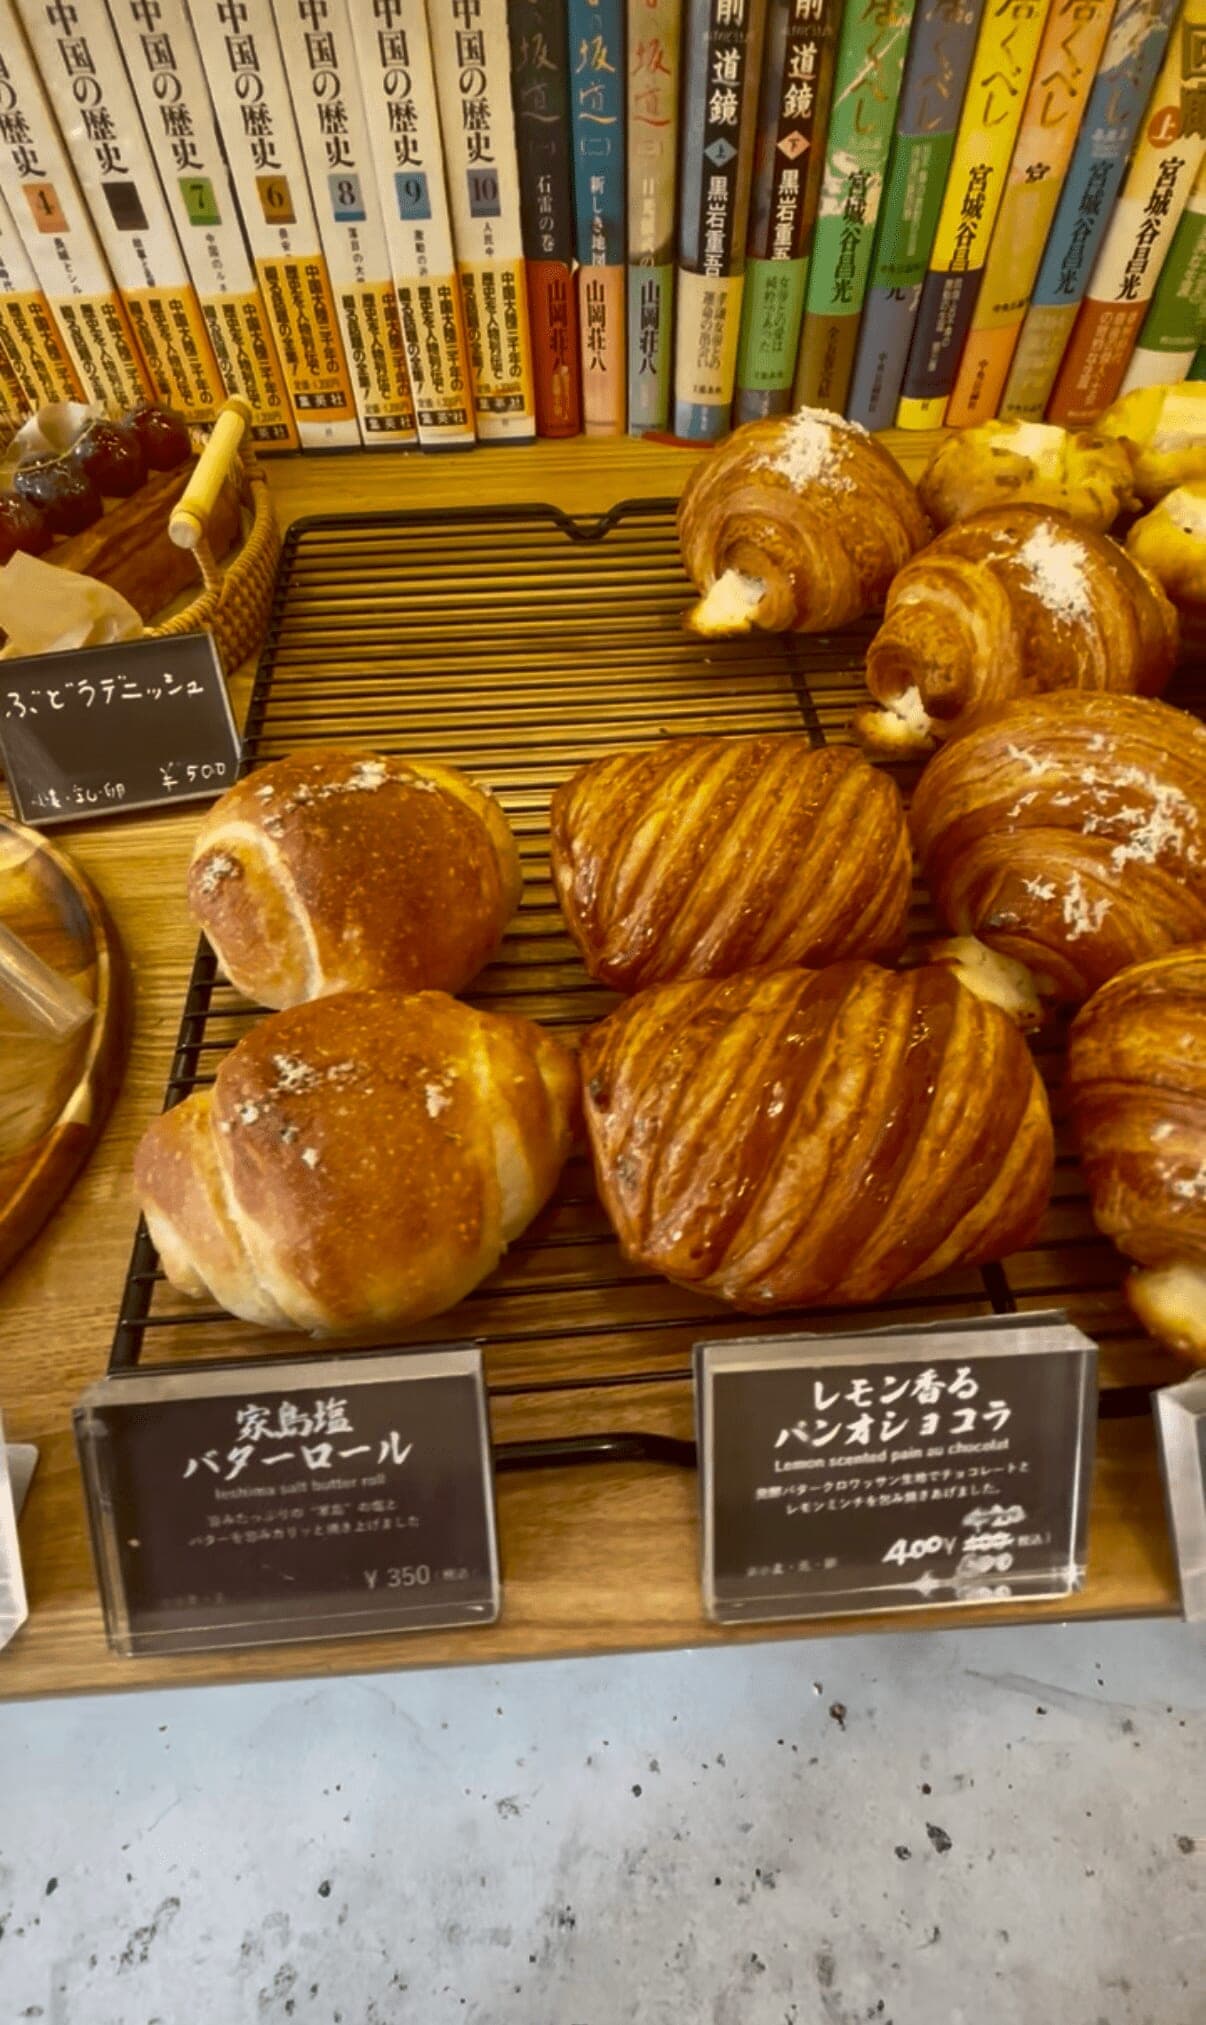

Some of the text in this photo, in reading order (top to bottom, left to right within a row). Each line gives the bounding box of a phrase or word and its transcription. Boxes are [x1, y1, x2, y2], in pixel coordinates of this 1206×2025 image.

[46, 0, 129, 175] 中国の歴史
[130, 0, 204, 171] 中国の歴史
[217, 0, 282, 170] 中国の歴史
[298, 0, 355, 168] 中国の歴史
[373, 0, 423, 166] 中国の歴史
[452, 0, 495, 163] 中国の歴史
[0, 53, 47, 177] の歴史
[1151, 112, 1175, 141] 上
[190, 184, 204, 209] 7
[266, 183, 284, 208] 6
[337, 180, 356, 205] 8
[404, 179, 422, 204] 9
[473, 177, 498, 203] 10
[702, 175, 728, 278] 黒岩重吾
[831, 170, 871, 304] 宮城谷昌光
[1053, 159, 1114, 295] 宮城谷昌光
[1114, 156, 1186, 301] 宮城谷昌光
[6, 673, 205, 718] ぶどうデニッシュ
[813, 1366, 979, 1412] レモン香る
[235, 1396, 354, 1442] 家島塩
[773, 1400, 1012, 1448] パンオショコラ
[182, 1430, 414, 1481] バターロール
[774, 1438, 1011, 1473] Lemon scented pain au chocolat
[311, 1477, 356, 1492] butter
[361, 1472, 387, 1486] roll
[387, 1565, 430, 1587] 350
